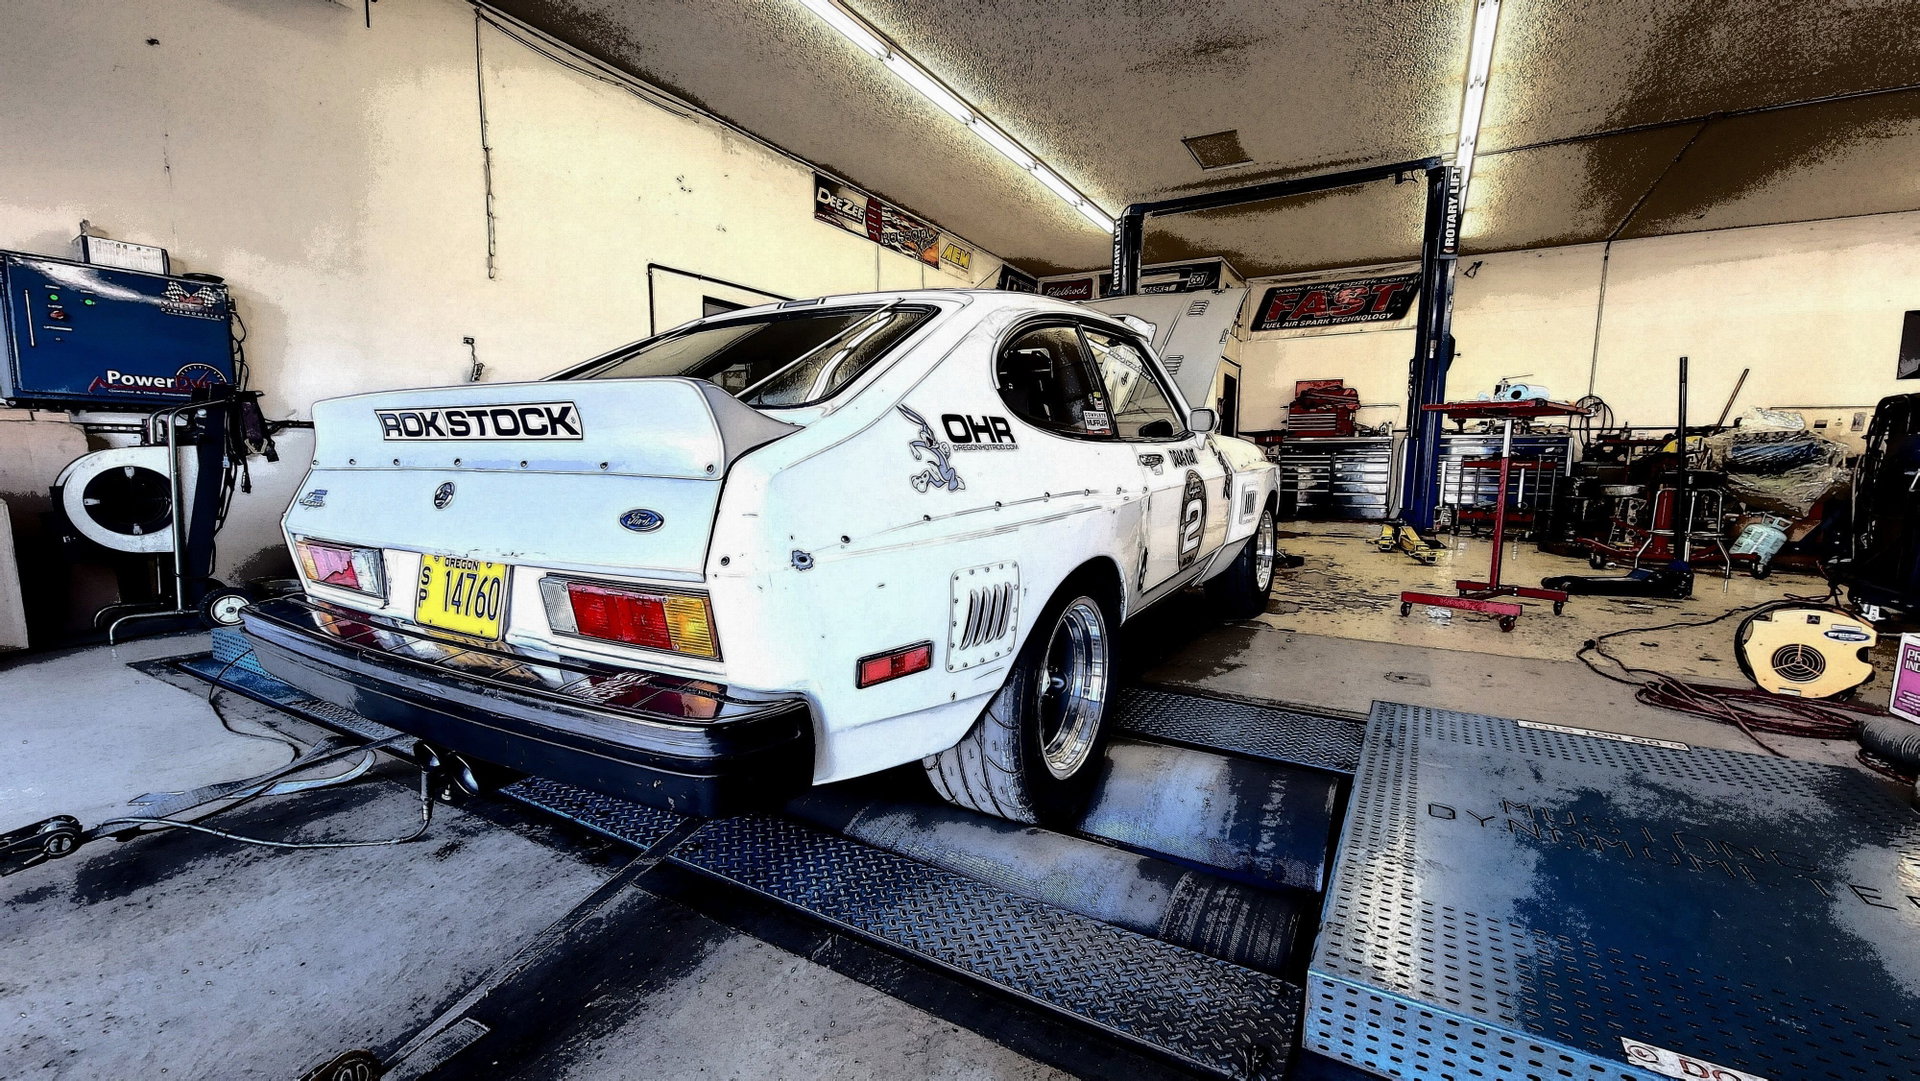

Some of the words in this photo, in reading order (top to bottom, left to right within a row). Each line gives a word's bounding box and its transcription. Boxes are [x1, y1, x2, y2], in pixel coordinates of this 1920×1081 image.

[1449, 167, 1462, 195] LIFT
[1444, 198, 1460, 247] ROTARY
[941, 243, 971, 269] AEM
[1113, 244, 1121, 285] ROTARY
[1046, 285, 1088, 296] Edelbrock
[1265, 282, 1406, 322] FAST
[160, 307, 225, 320] DYNAMOMETER
[1299, 318, 1329, 327] SPARK
[1331, 312, 1394, 325] TECHNOLOGY
[941, 413, 1016, 443] OHR
[628, 513, 652, 526] Ford
[1182, 498, 1203, 554] 2
[445, 557, 480, 571] OREGON
[444, 570, 501, 621] 14760
[1526, 722, 1572, 733] STEP
[1584, 730, 1622, 740] NOT
[1631, 737, 1662, 746] DO
